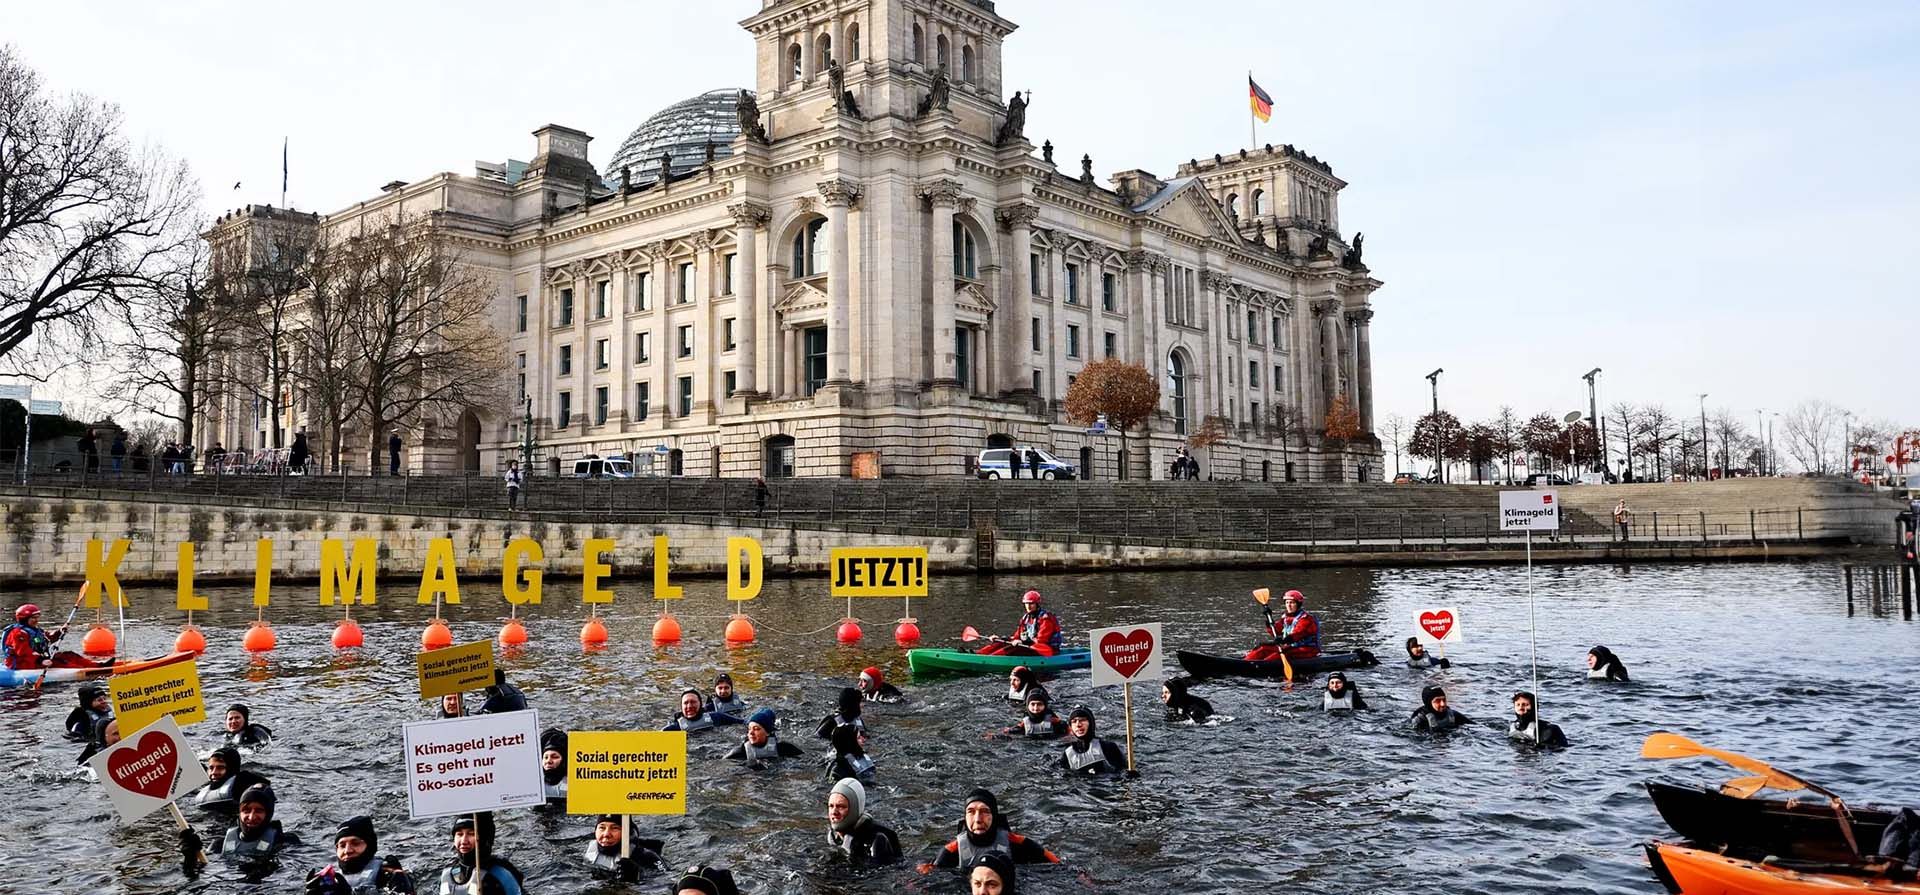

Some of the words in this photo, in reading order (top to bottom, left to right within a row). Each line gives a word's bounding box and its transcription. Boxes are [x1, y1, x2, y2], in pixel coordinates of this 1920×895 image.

[1504, 508, 1553, 517] Klimageld
[1505, 518, 1531, 527] jetzt!
[835, 557, 923, 587] JETZT!
[1104, 641, 1149, 654] Klimageld
[423, 659, 445, 670] Sozial
[446, 653, 482, 667] gerechter
[1115, 653, 1139, 666] jetzt!
[424, 665, 468, 680] Klimaschutz
[470, 660, 489, 672] jetzt!
[117, 687, 142, 700] Sozial
[144, 679, 185, 696] gerechter
[119, 694, 170, 712] Klimaschutz
[172, 687, 194, 702] jetzt!
[415, 738, 485, 756] Klimageld
[489, 733, 525, 750] jetzt!
[116, 743, 171, 780] Klimageld
[416, 763, 433, 774] Es
[437, 758, 469, 774] geht
[473, 756, 496, 767] nur
[576, 751, 609, 763] Sozial
[612, 751, 668, 765] gerechter
[136, 763, 167, 789] jetzt!
[418, 772, 493, 791] öko-sozial!
[576, 767, 645, 779] Klimaschutz
[647, 767, 677, 782] jetzt!
[626, 792, 676, 801] GREENPEACE
